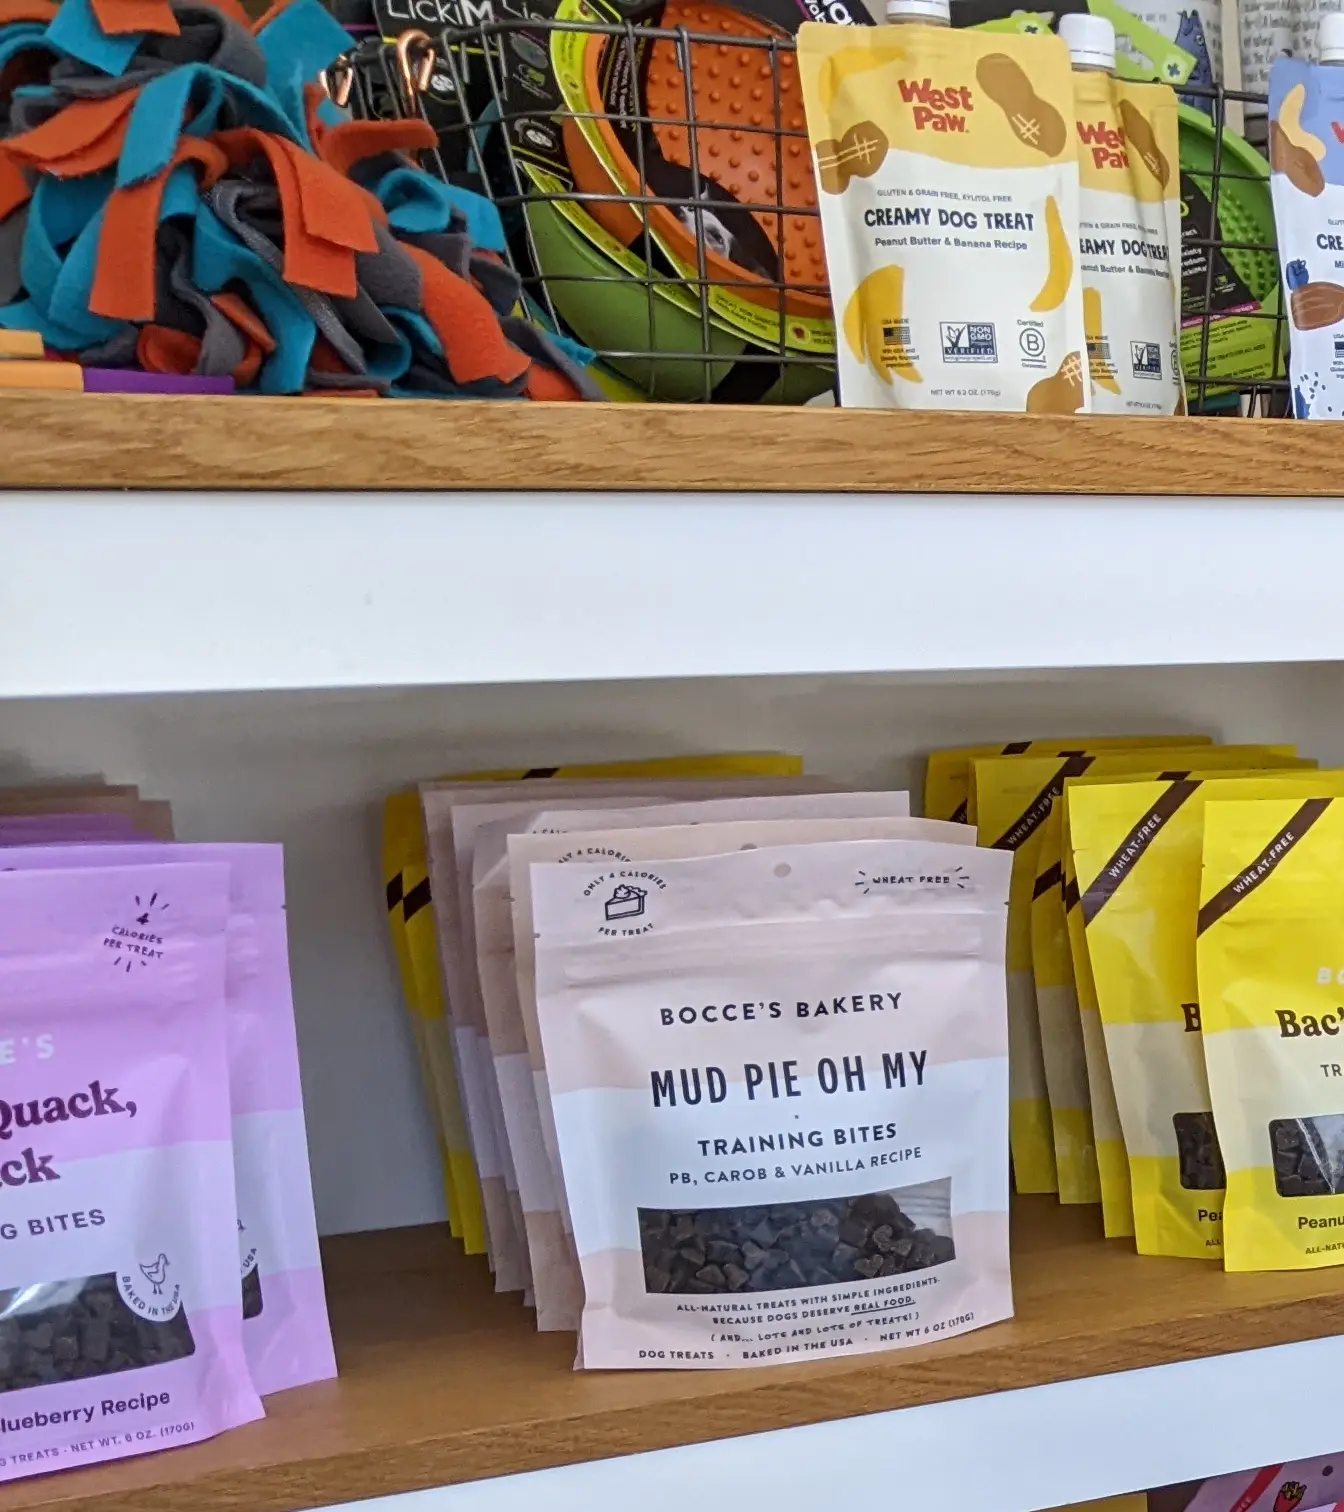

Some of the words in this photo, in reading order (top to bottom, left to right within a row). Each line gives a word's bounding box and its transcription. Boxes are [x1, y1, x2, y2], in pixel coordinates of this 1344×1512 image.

[897, 78, 974, 112] West
[864, 208, 931, 228] CREAMY
[938, 209, 978, 229] DOG
[984, 213, 1034, 232] TREAT
[875, 237, 908, 247] Peanut
[910, 236, 942, 247] Butter
[945, 238, 951, 246] &
[954, 239, 992, 249] Banana
[994, 240, 1028, 251] Recipe
[1122, 240, 1147, 258] DOG
[969, 325, 991, 333] NON
[1016, 319, 1044, 327] Certified
[969, 333, 992, 341] GMO
[945, 346, 994, 354] VERIFIED
[1107, 812, 1163, 879] WHEAT-FREE
[1232, 830, 1296, 894] WHEAT-FREE
[872, 875, 913, 885] WHEAT
[919, 875, 950, 885] FREE
[112, 926, 163, 944] CALORIES
[599, 926, 617, 936] PER
[621, 922, 655, 936] TREAT
[103, 938, 122, 949] PER
[126, 944, 164, 959] TREAT
[660, 1001, 783, 1026] BOCCE'S
[796, 991, 903, 1019] BAKERY
[650, 1066, 727, 1108] MUD
[745, 1060, 802, 1100] PIE
[818, 1055, 865, 1094] OH
[882, 1049, 929, 1089] MY
[697, 1129, 825, 1158] TRAINING
[834, 1122, 897, 1144] BITES
[669, 1172, 698, 1186] PB,
[704, 1167, 768, 1184] CAROB
[774, 1166, 786, 1178] &
[790, 1159, 865, 1178] VANILLA
[870, 1147, 922, 1167] RECIPE
[28, 1208, 106, 1236] BITES
[756, 1300, 796, 1310] TREATS
[800, 1295, 828, 1305] WITH
[831, 1290, 870, 1302] SIMPLE
[713, 1315, 764, 1325] BECAUSE
[767, 1312, 798, 1322] DOGS
[801, 1305, 850, 1320] DESERVE
[854, 1302, 880, 1312] REAL
[638, 1350, 665, 1359] DOG
[669, 1350, 714, 1360] TREATS
[742, 1346, 782, 1360] BAKED
[786, 1344, 800, 1353] IN
[804, 1341, 827, 1351] THE
[830, 1337, 854, 1347] USA
[879, 1332, 902, 1342] NET
[101, 1391, 170, 1416] Recipe
[10, 1447, 59, 1465] TREATS
[71, 1441, 94, 1453] NET
